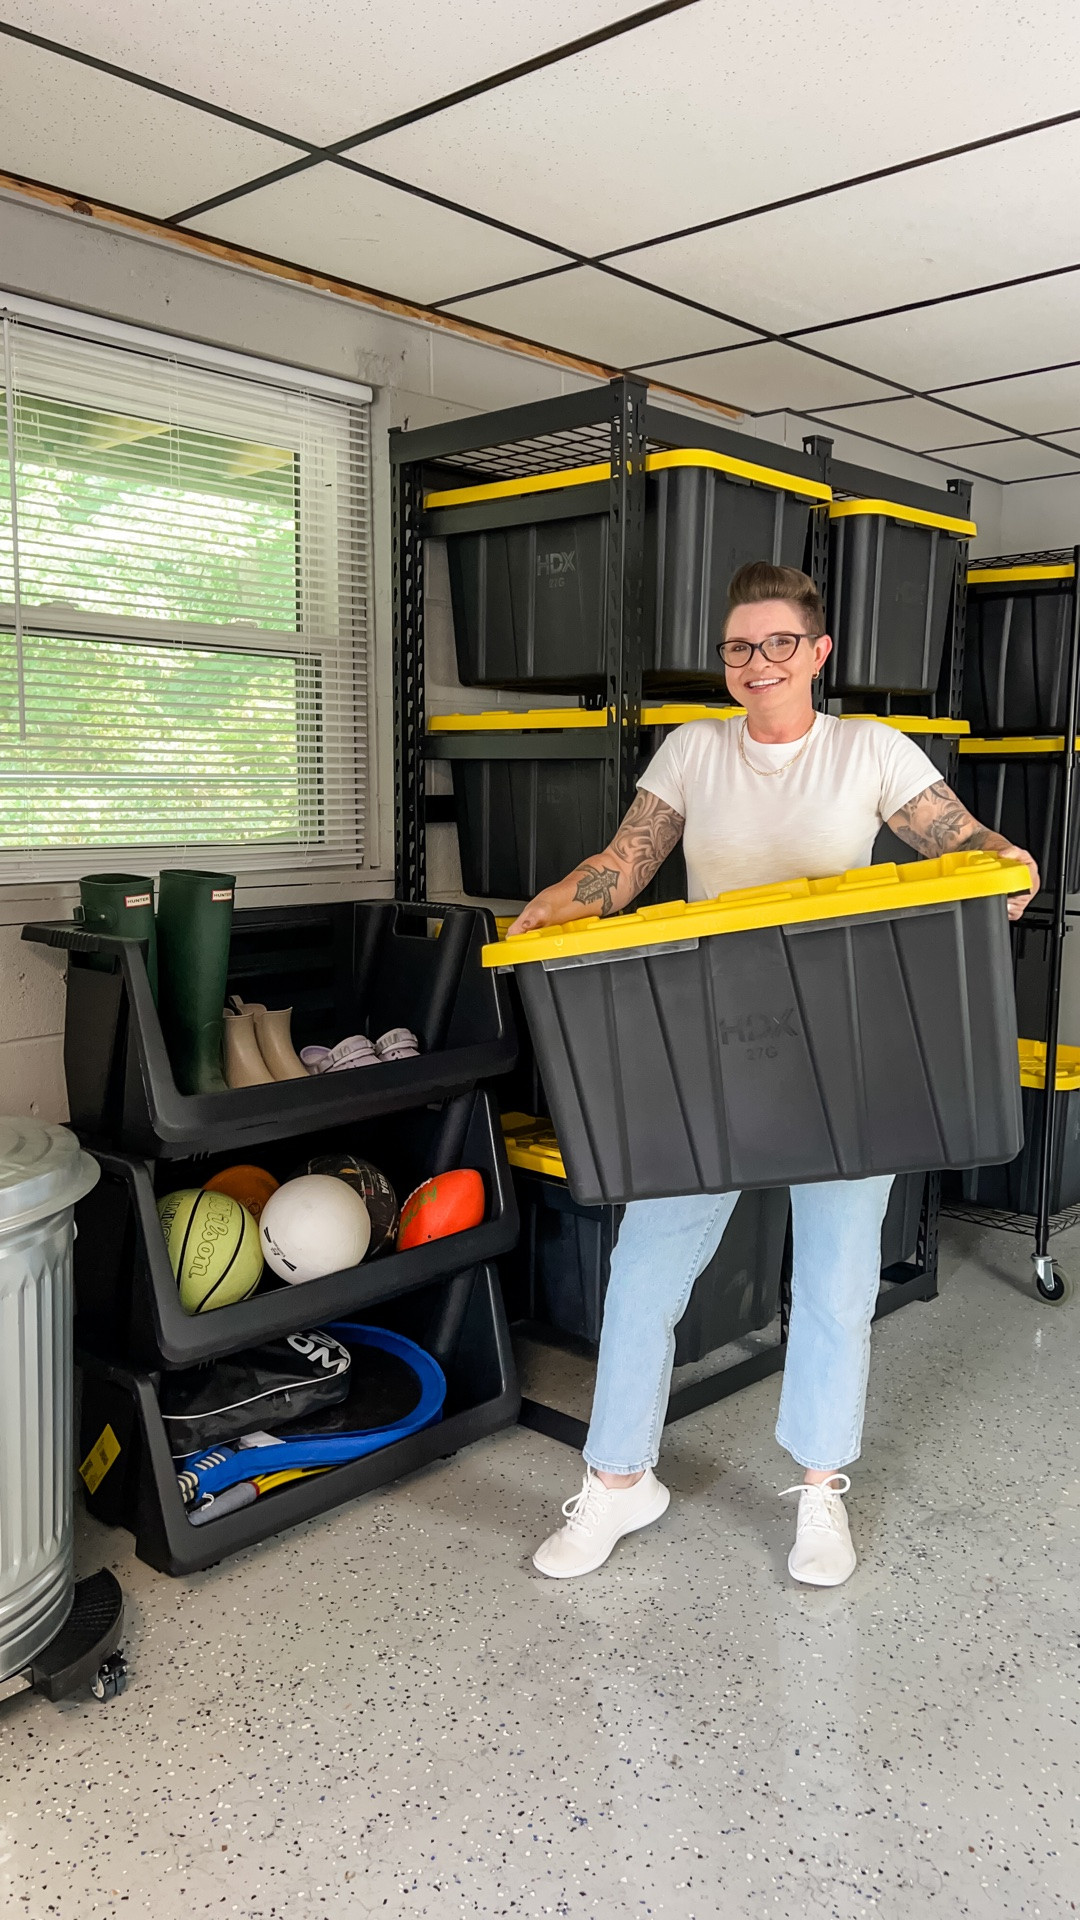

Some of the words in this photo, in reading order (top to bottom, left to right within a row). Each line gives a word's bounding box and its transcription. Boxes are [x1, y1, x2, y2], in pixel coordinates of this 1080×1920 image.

[537, 551, 576, 576] HDX
[127, 896, 149, 904] HUNTER
[719, 1008, 799, 1046] HDX
[747, 1047, 778, 1061] 27G
[188, 1196, 234, 1279] Wilson
